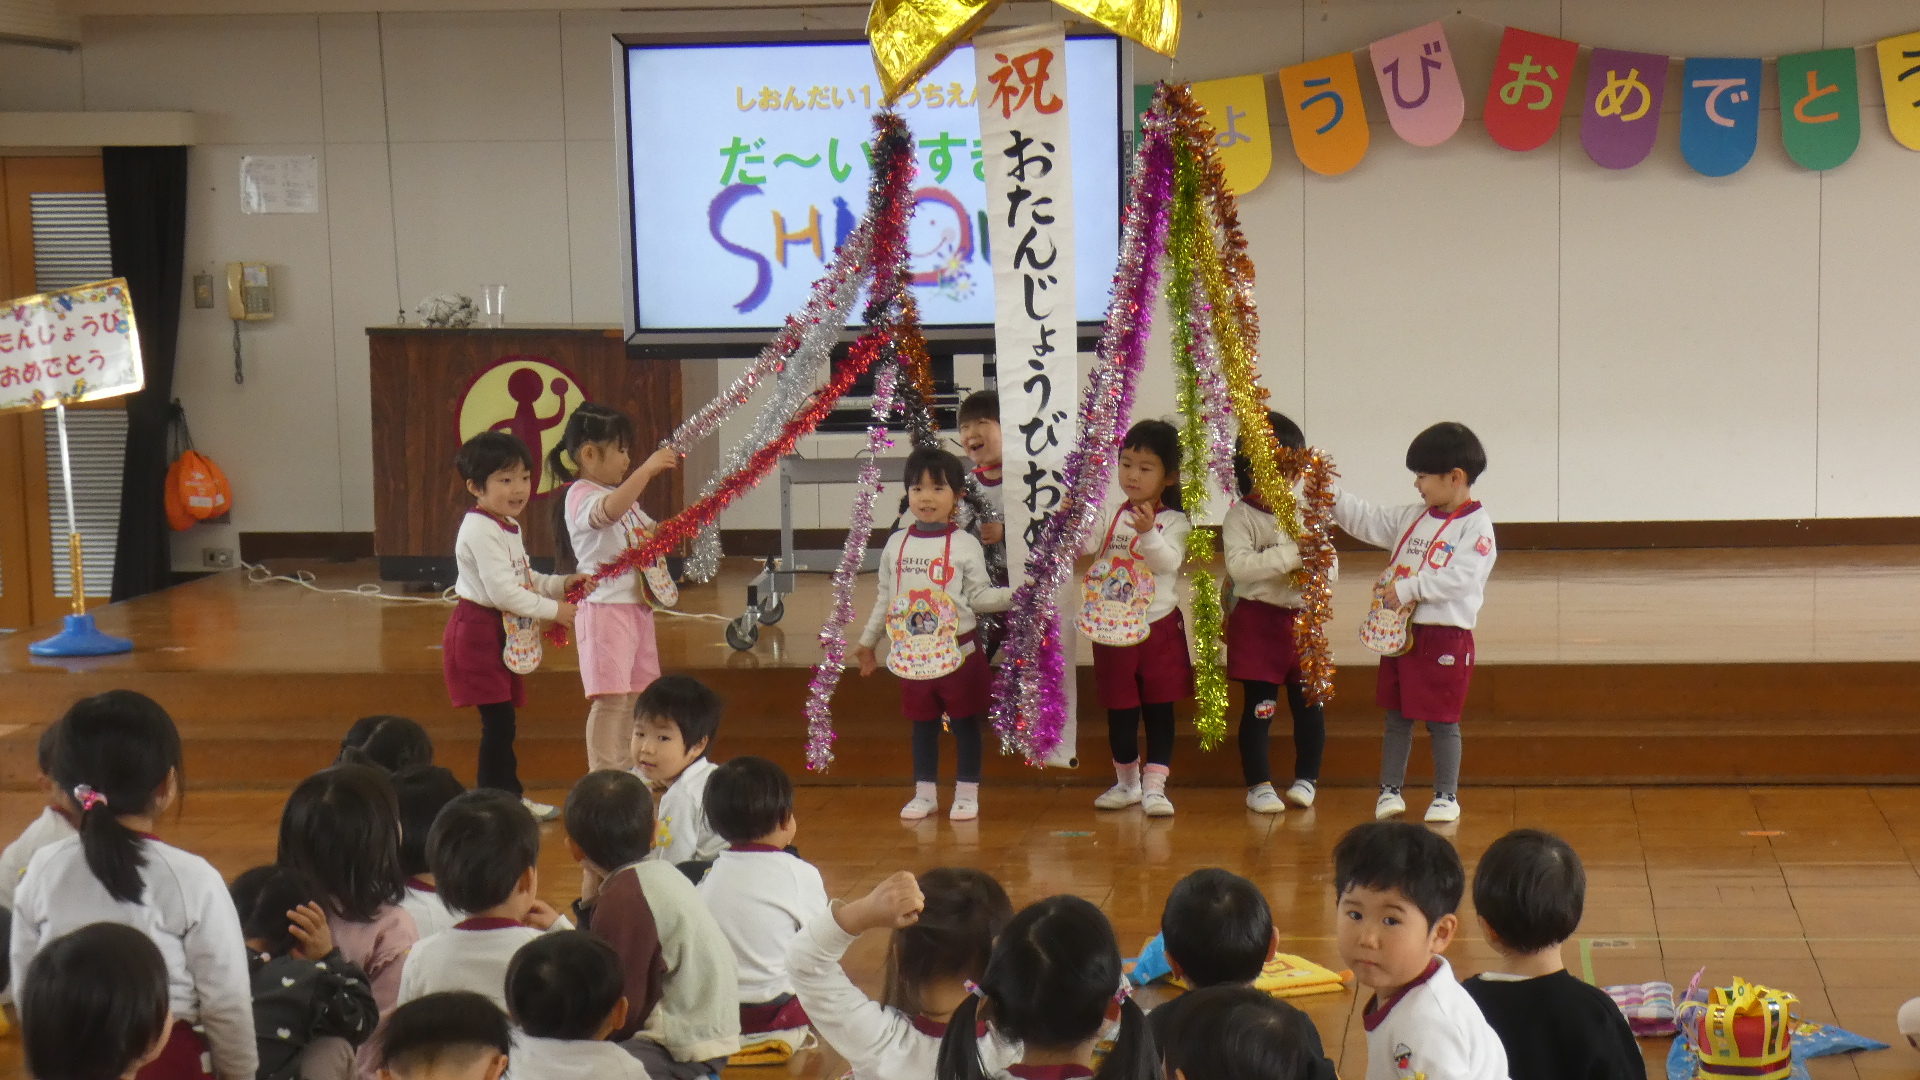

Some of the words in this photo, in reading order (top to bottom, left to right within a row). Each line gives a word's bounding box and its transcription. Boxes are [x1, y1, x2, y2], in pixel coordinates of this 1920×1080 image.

[0, 349, 105, 388] おめでとう
